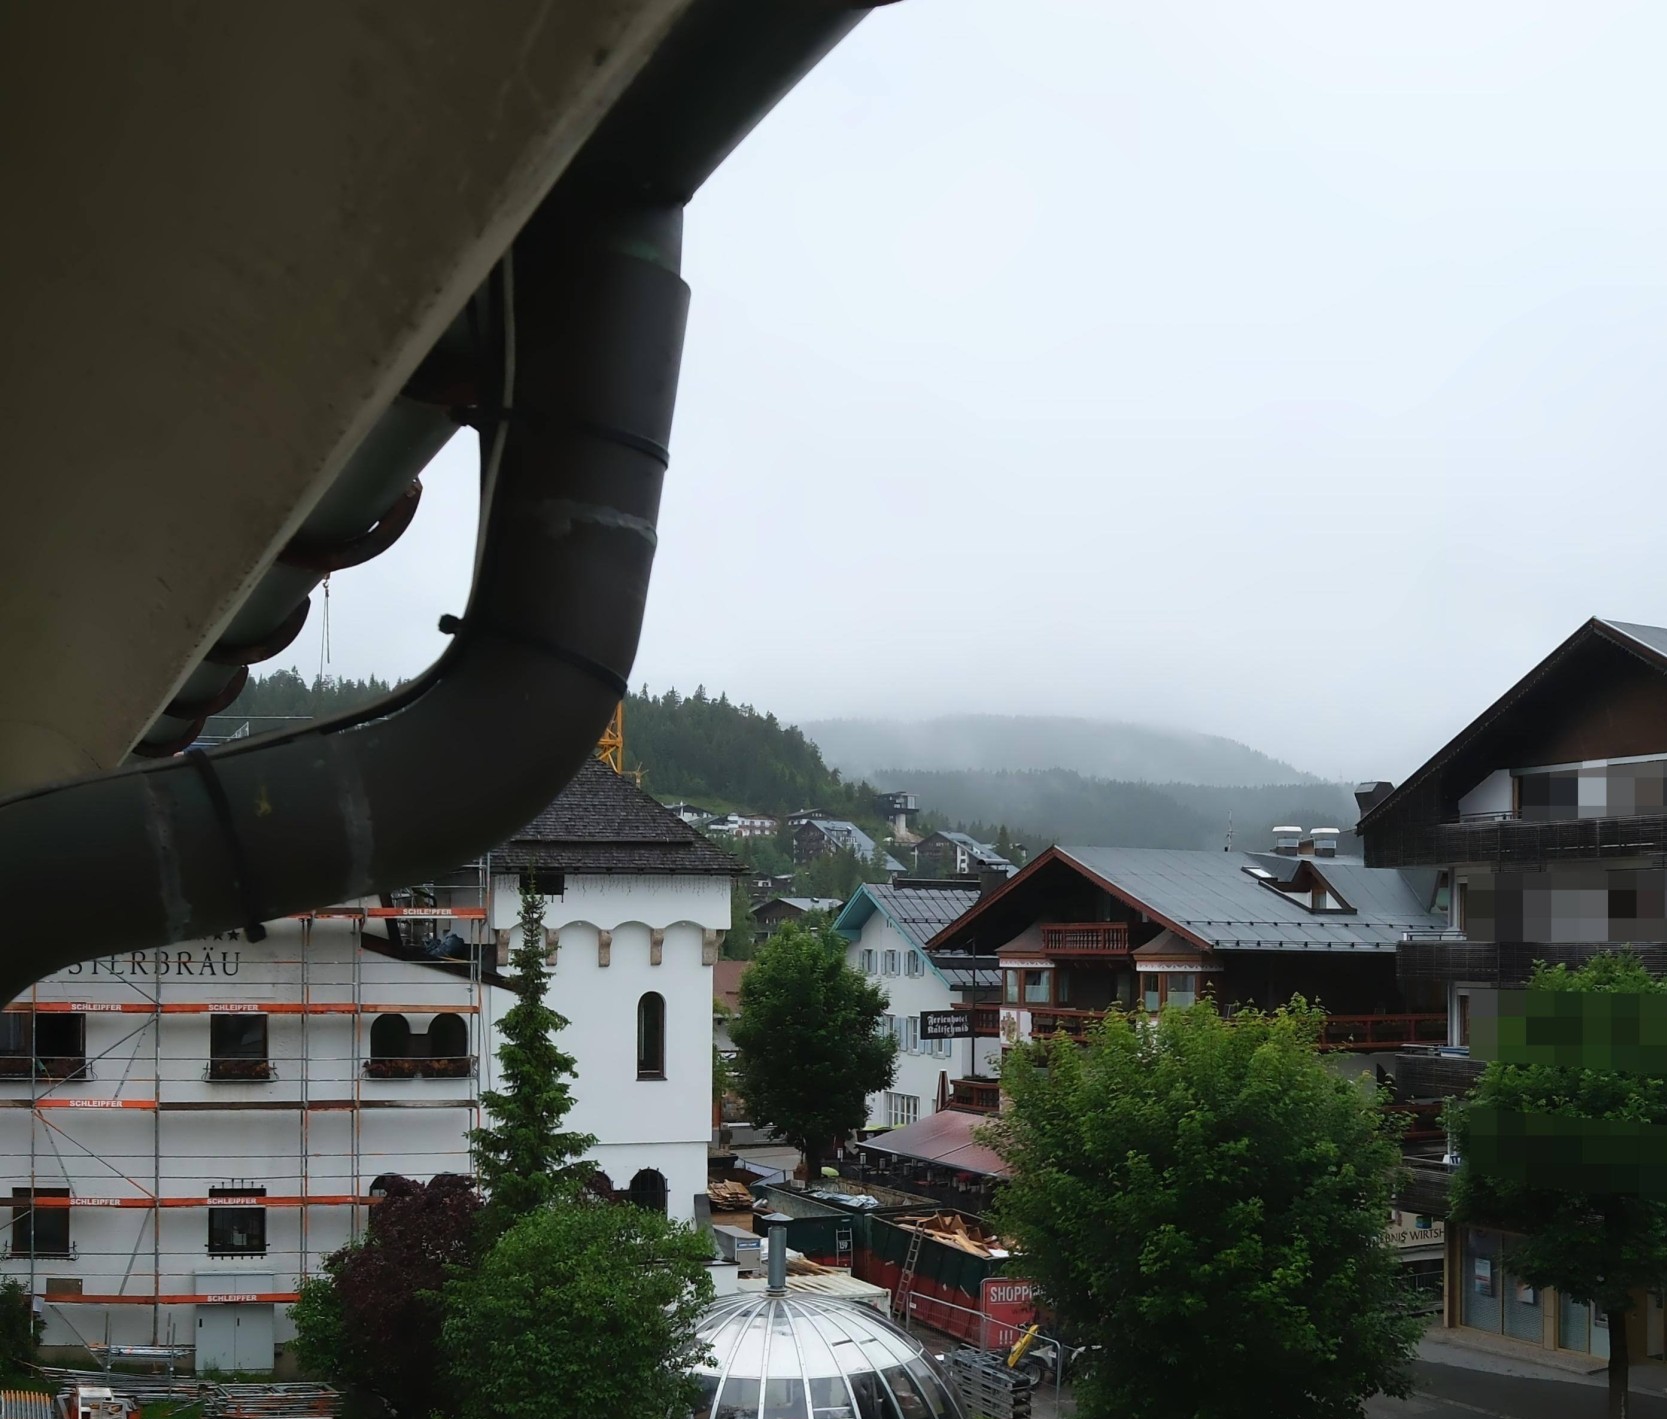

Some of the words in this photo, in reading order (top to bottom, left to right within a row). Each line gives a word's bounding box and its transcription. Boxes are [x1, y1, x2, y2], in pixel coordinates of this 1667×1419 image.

[402, 908, 452, 916] SCHLEIPFER
[71, 1003, 122, 1011] SCHLEIPFER
[208, 1003, 259, 1011] SCHLEIPFER
[69, 1100, 123, 1108] SCHLEIPFER
[69, 1198, 121, 1206] SCHLEIPFER
[206, 1197, 257, 1205] SCHLEIPFER
[990, 1285, 1038, 1302] SHOPPI
[207, 1294, 257, 1302] SCHLEIPFER
